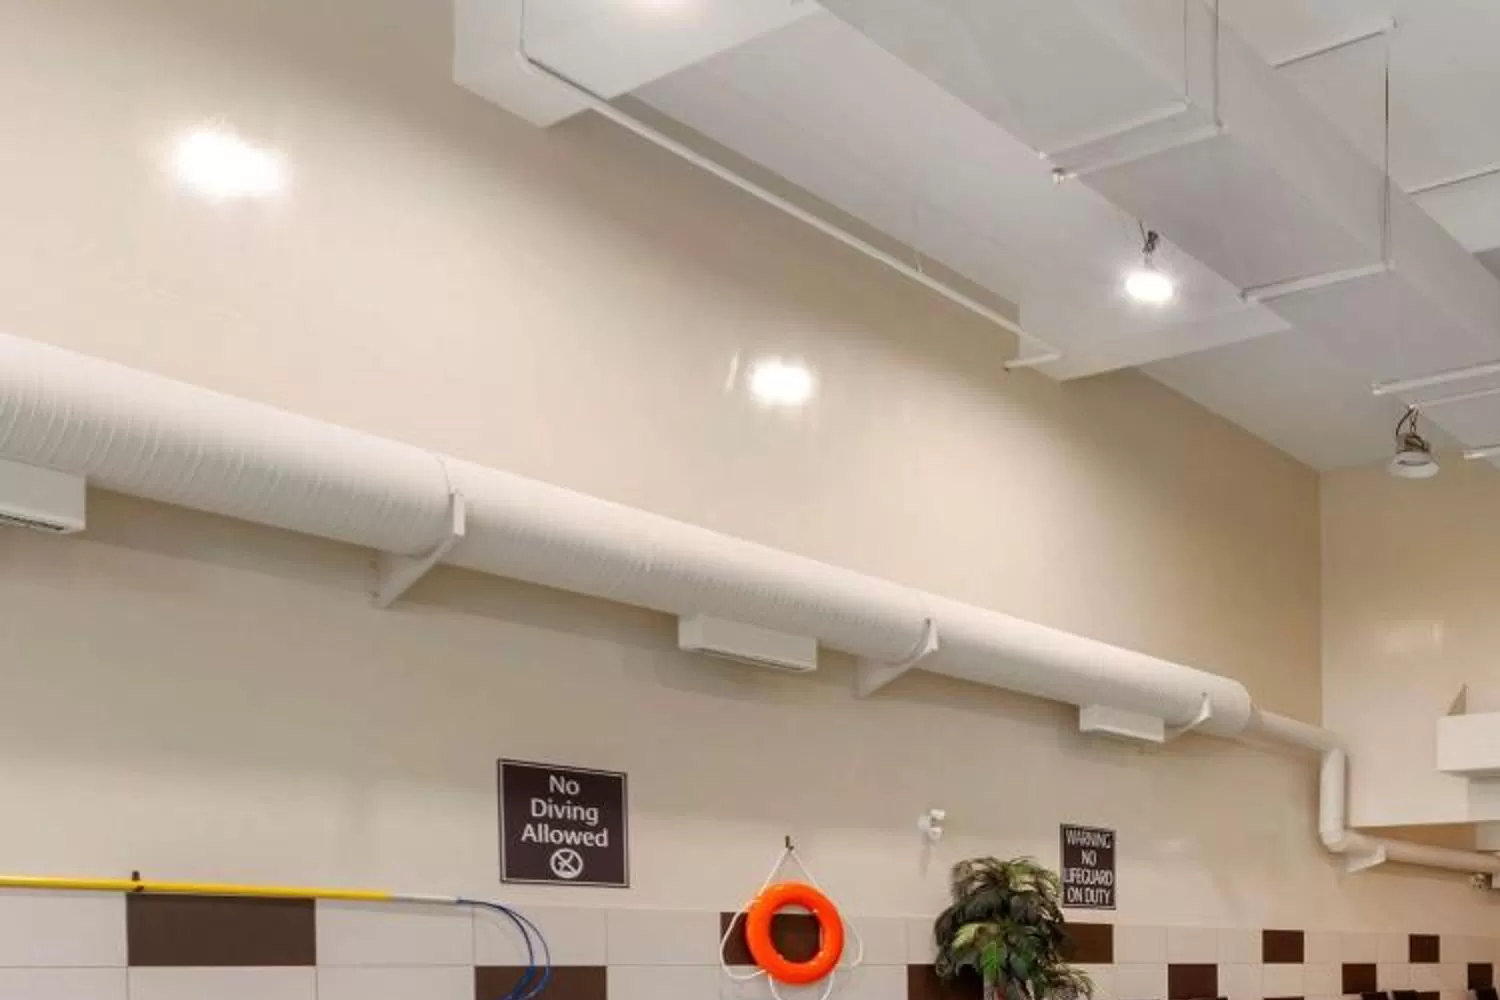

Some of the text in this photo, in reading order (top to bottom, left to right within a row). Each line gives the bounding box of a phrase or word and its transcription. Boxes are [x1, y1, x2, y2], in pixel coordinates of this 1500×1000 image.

[550, 775, 580, 795] No
[531, 797, 599, 826] Diving
[521, 822, 609, 847] Allowed
[1065, 829, 1112, 849] WARNING
[1081, 849, 1097, 867] NO
[1063, 867, 1113, 886] LIFEGUARD
[1067, 885, 1111, 905] ON DUTY
